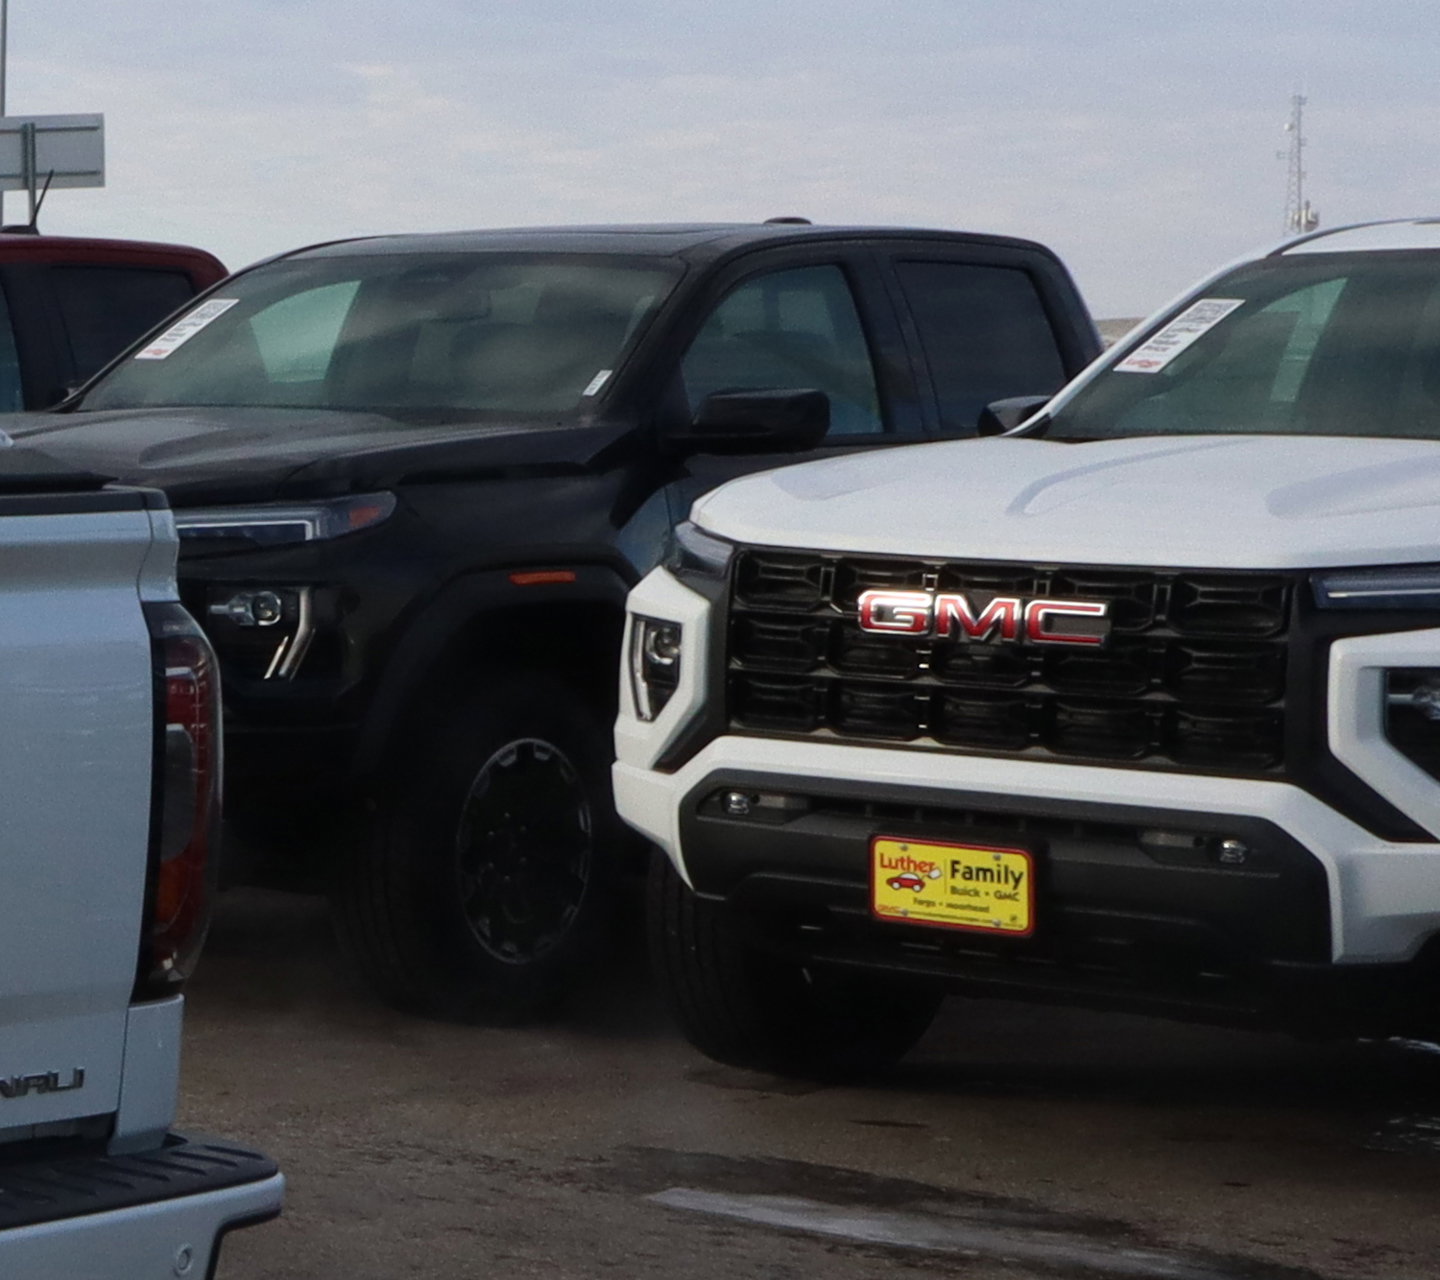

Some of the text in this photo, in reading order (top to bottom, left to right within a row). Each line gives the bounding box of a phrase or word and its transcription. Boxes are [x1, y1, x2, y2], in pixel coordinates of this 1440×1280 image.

[858, 589, 1107, 647] GMC
[879, 852, 1024, 890] Luther Family
[950, 885, 1021, 902] Buick GMC
